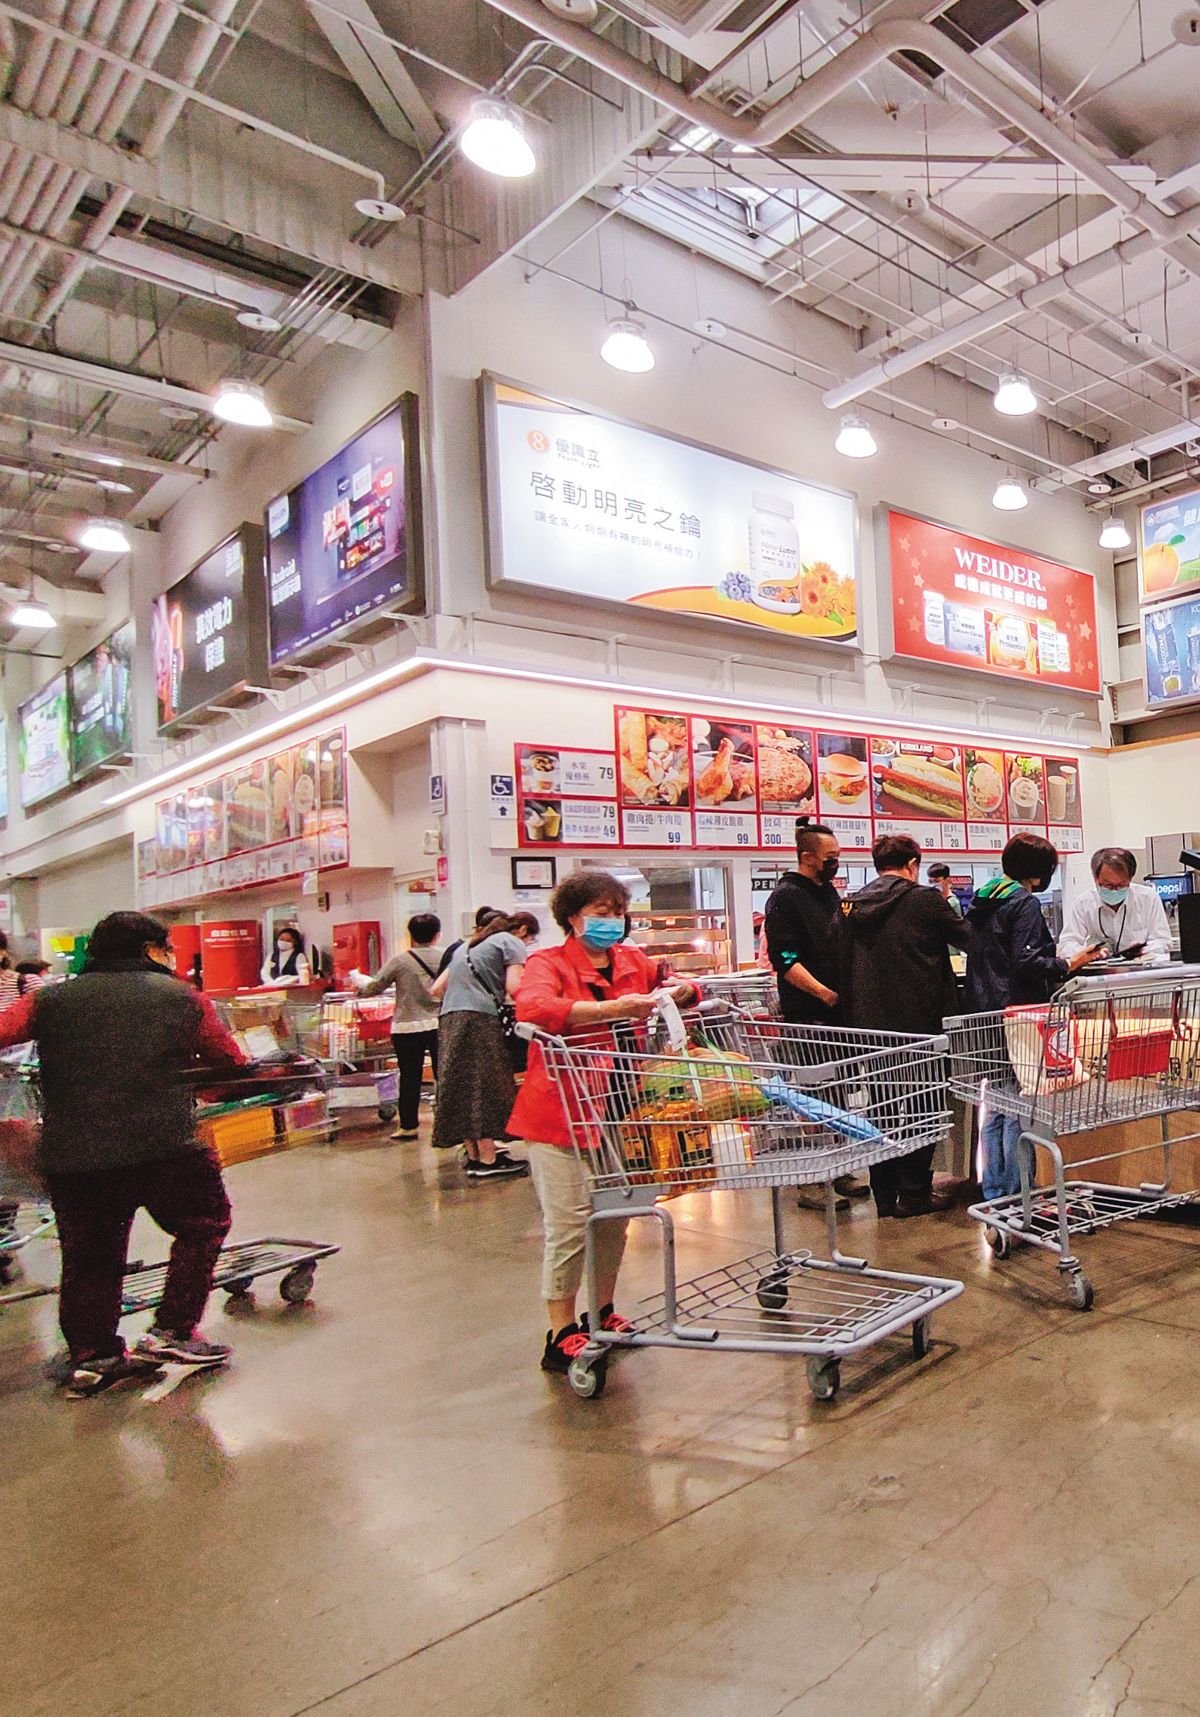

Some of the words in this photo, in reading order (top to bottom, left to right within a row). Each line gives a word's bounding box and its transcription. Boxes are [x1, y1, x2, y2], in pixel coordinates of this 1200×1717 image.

[953, 547, 1044, 592] WEIDER
[599, 766, 614, 780] 79
[602, 805, 615, 818] 79
[603, 825, 616, 837] 49
[668, 831, 681, 844] 99
[737, 833, 749, 845] 99
[764, 833, 782, 845] 300
[855, 836, 865, 846] 99
[925, 838, 934, 848] 50
[950, 838, 959, 848] 20
[1155, 881, 1183, 895] pepsi
